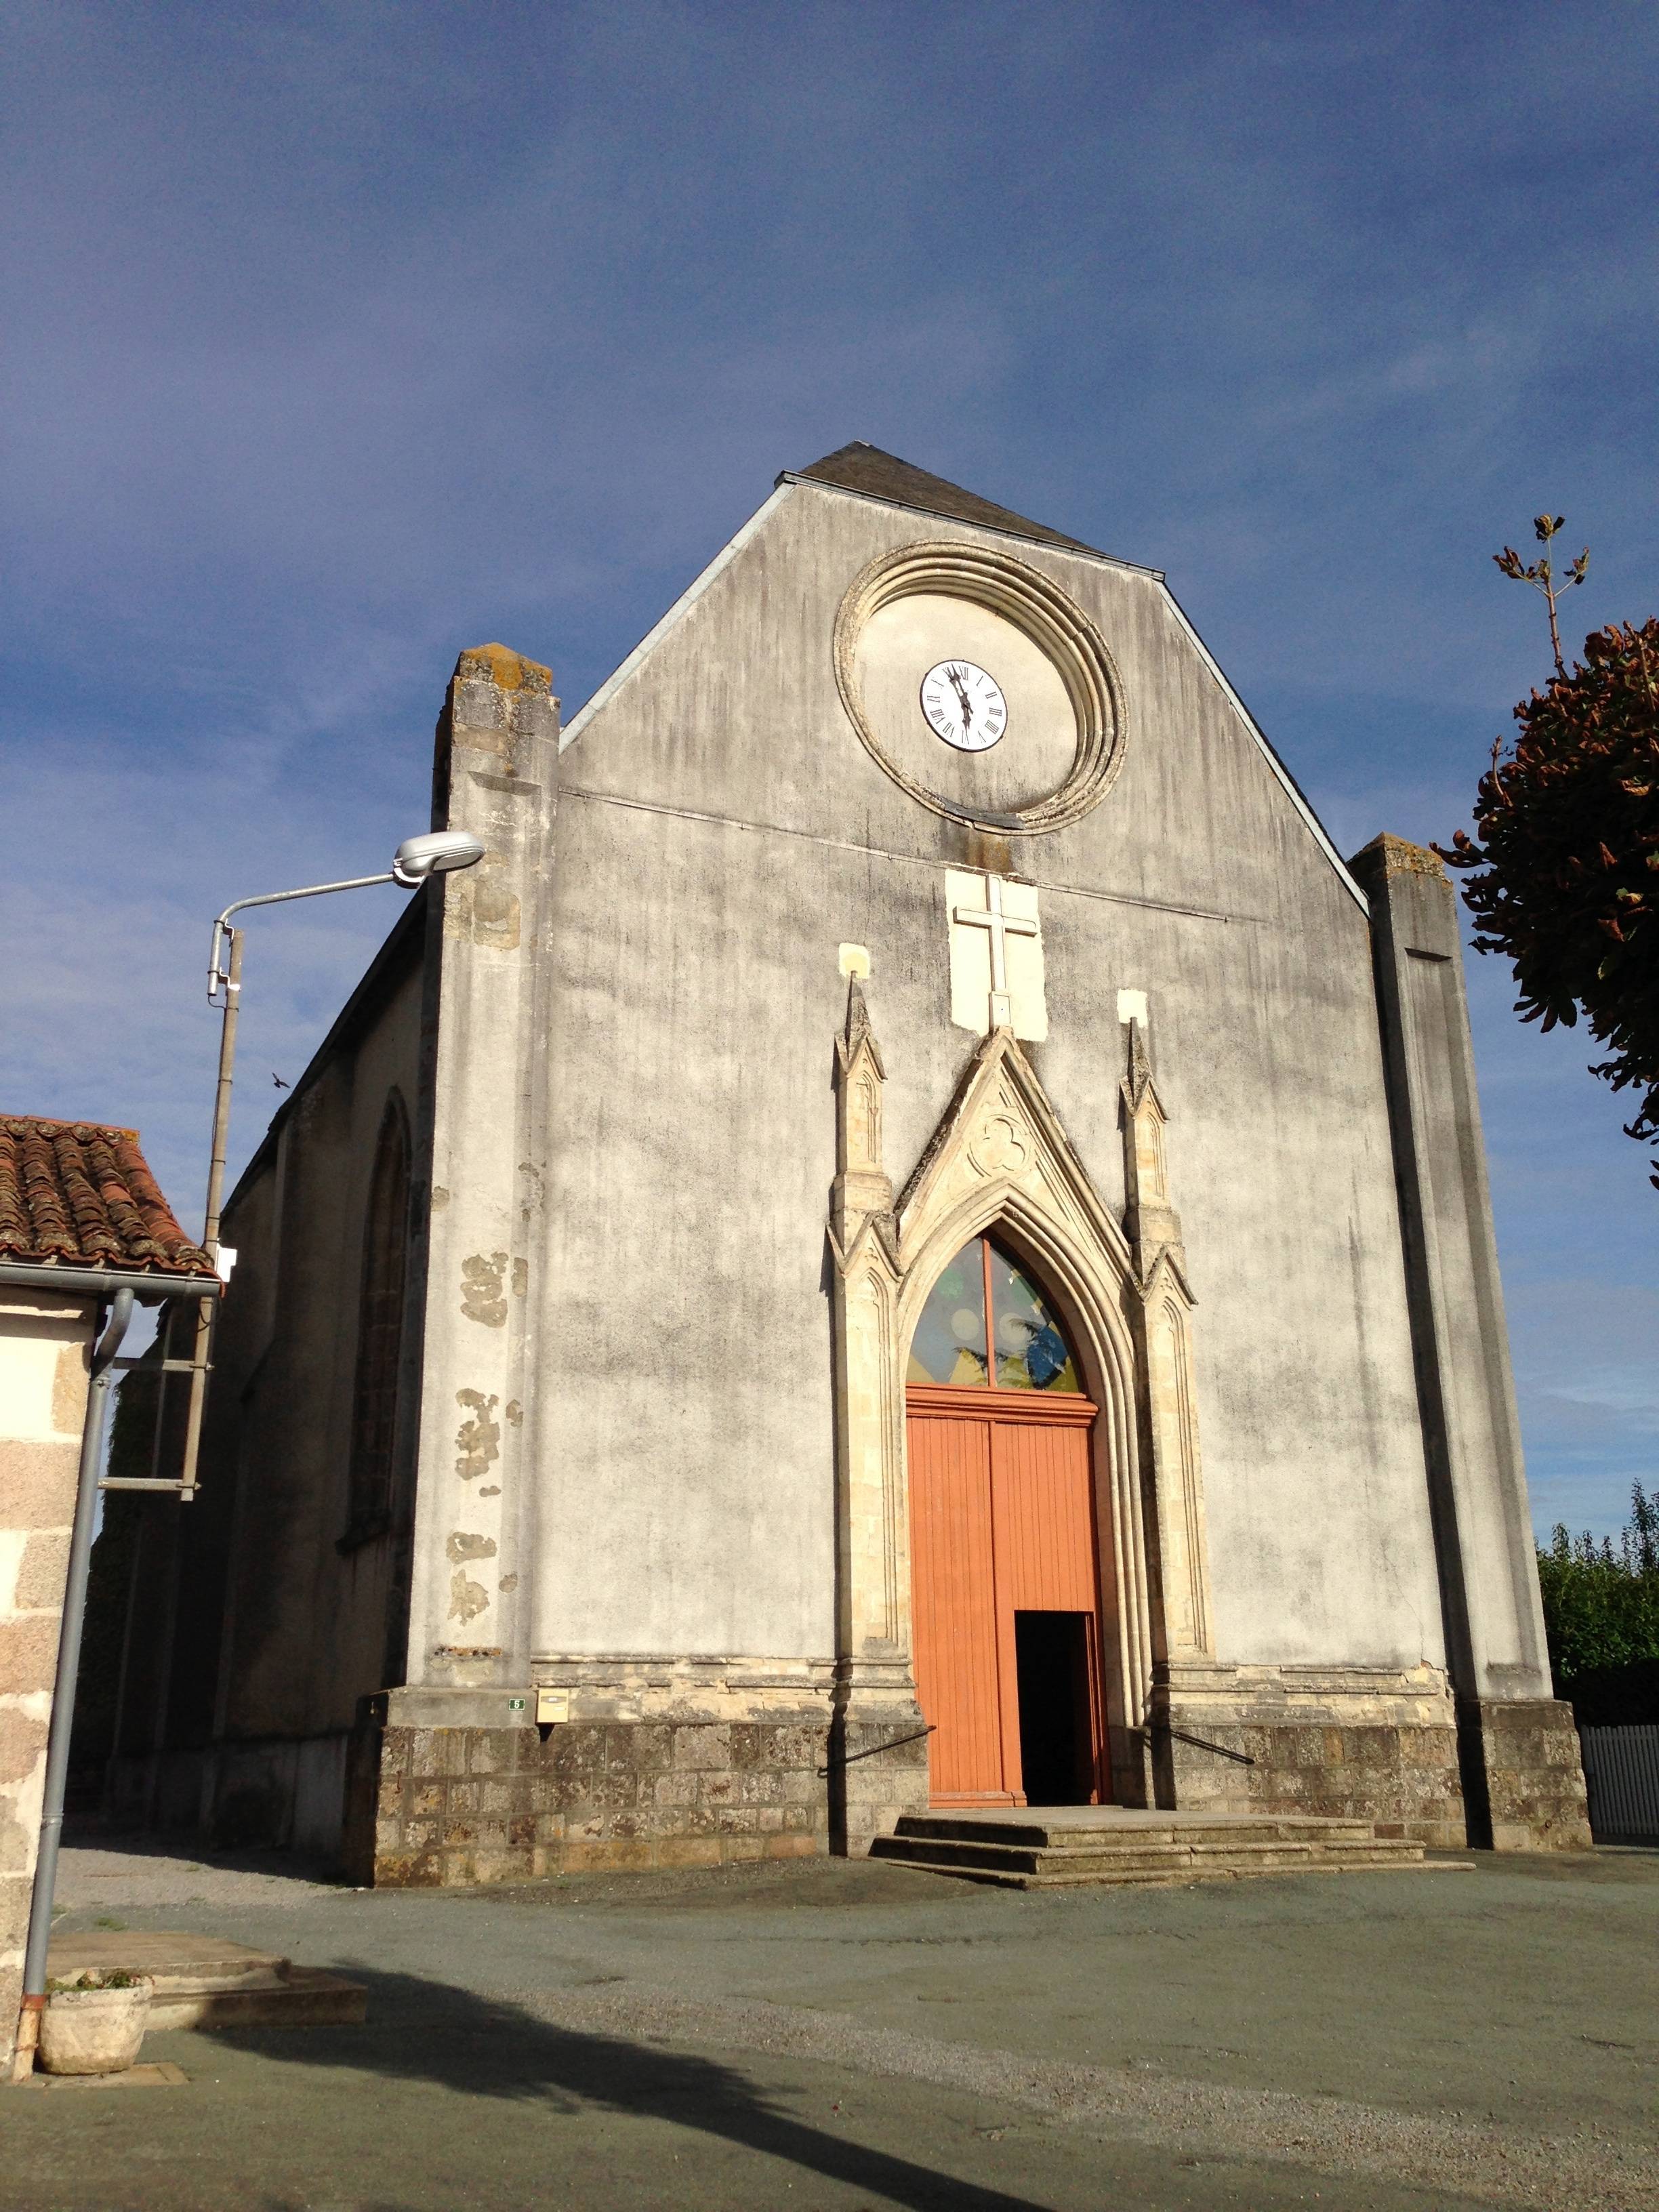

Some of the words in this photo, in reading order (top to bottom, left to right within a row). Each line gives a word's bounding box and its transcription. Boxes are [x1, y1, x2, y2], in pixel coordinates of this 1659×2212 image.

[976, 676, 983, 687] I
[989, 707, 1002, 716] III
[514, 1700, 520, 1708] 5
